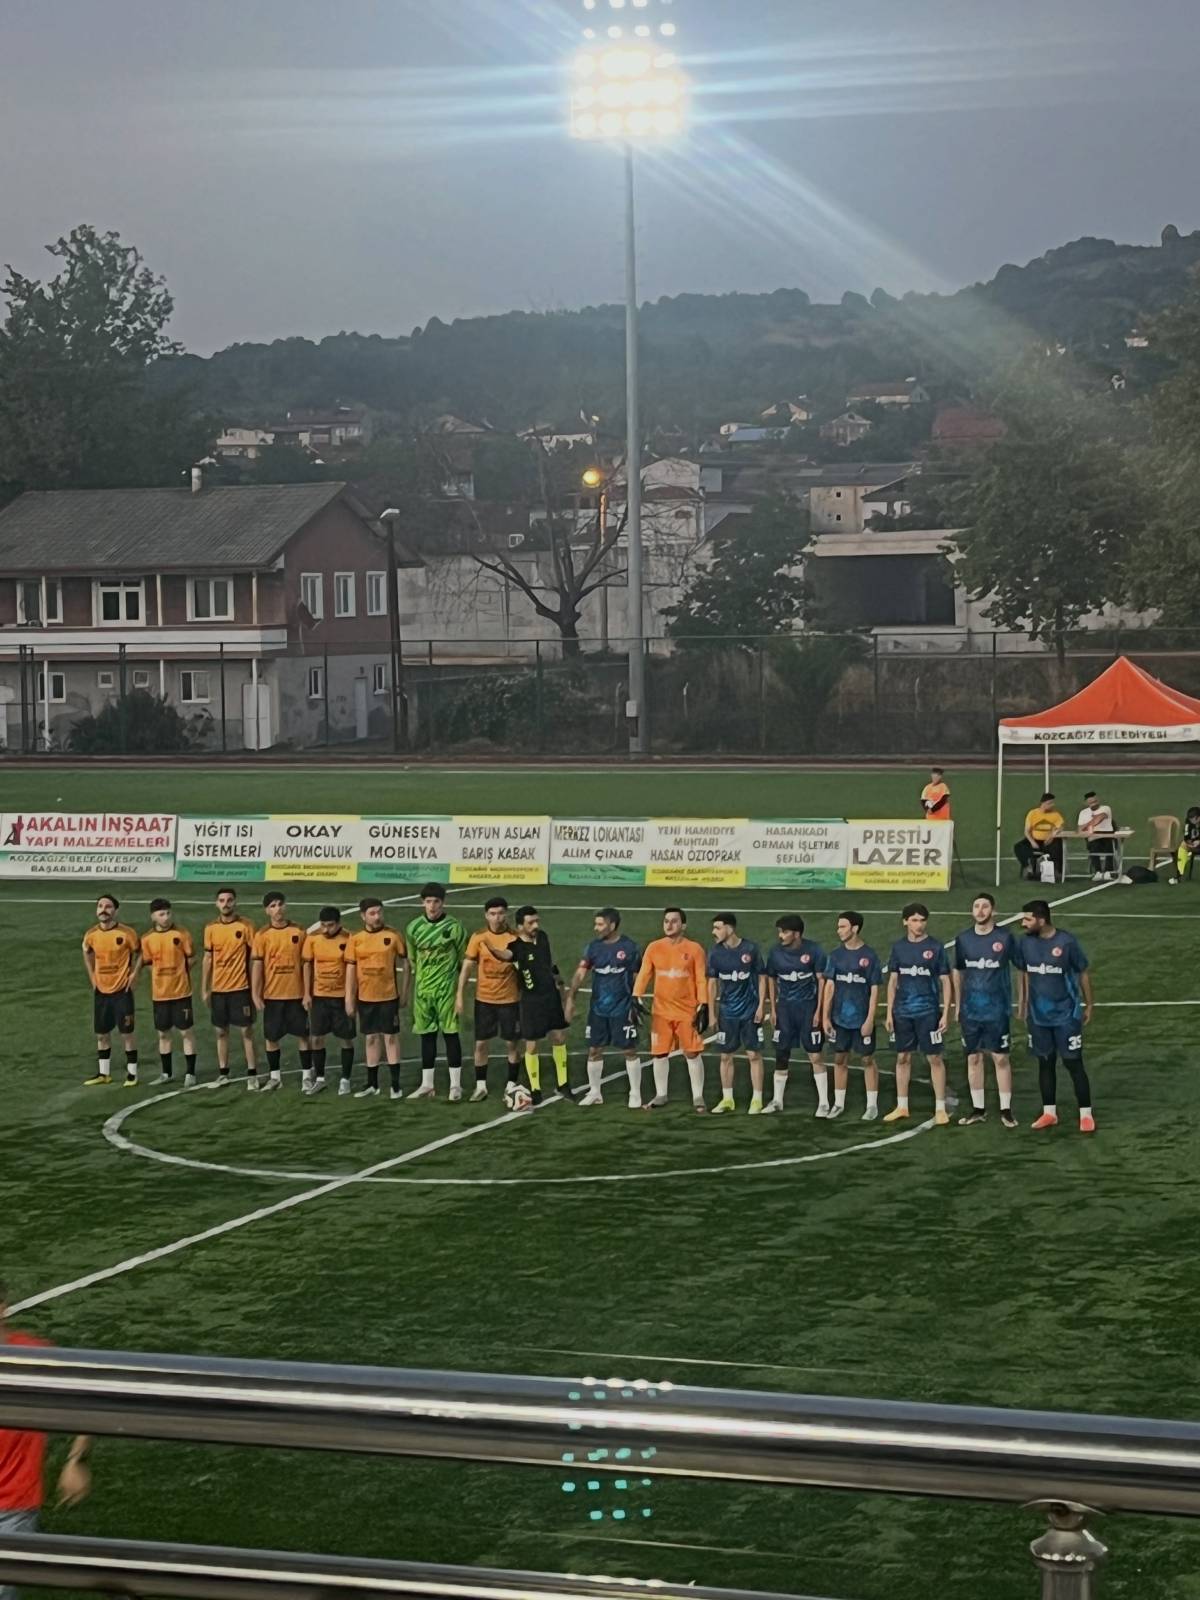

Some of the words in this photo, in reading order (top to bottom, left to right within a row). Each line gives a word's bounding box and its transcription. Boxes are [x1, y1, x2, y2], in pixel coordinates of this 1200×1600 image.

[26, 816, 98, 832] AKALIN
[101, 813, 173, 835] İNŞAAT
[194, 821, 231, 838] YİĞİT
[236, 825, 253, 838] ISI
[286, 825, 343, 838] OKAY
[459, 826, 500, 840] TAYFUN
[504, 827, 541, 840] ASLAN
[554, 825, 589, 841] MERKEZ
[593, 826, 644, 842] LOKANTASI
[766, 827, 828, 836] HASANKADI
[862, 825, 932, 844] PRESTİJ
[25, 836, 58, 847] YAPI
[63, 836, 170, 848] MALZEMELERİ
[752, 840, 794, 849] ORMAN
[184, 841, 261, 858] SİSTEMLERİ
[273, 845, 352, 858] KUYUMCULUK
[370, 844, 438, 859] MOBİLYA
[462, 847, 494, 864] BARIŞ
[497, 847, 535, 861] KABAK
[595, 849, 633, 861] ÇINAR
[650, 849, 684, 861] HASAN
[852, 848, 942, 866] LAZER
